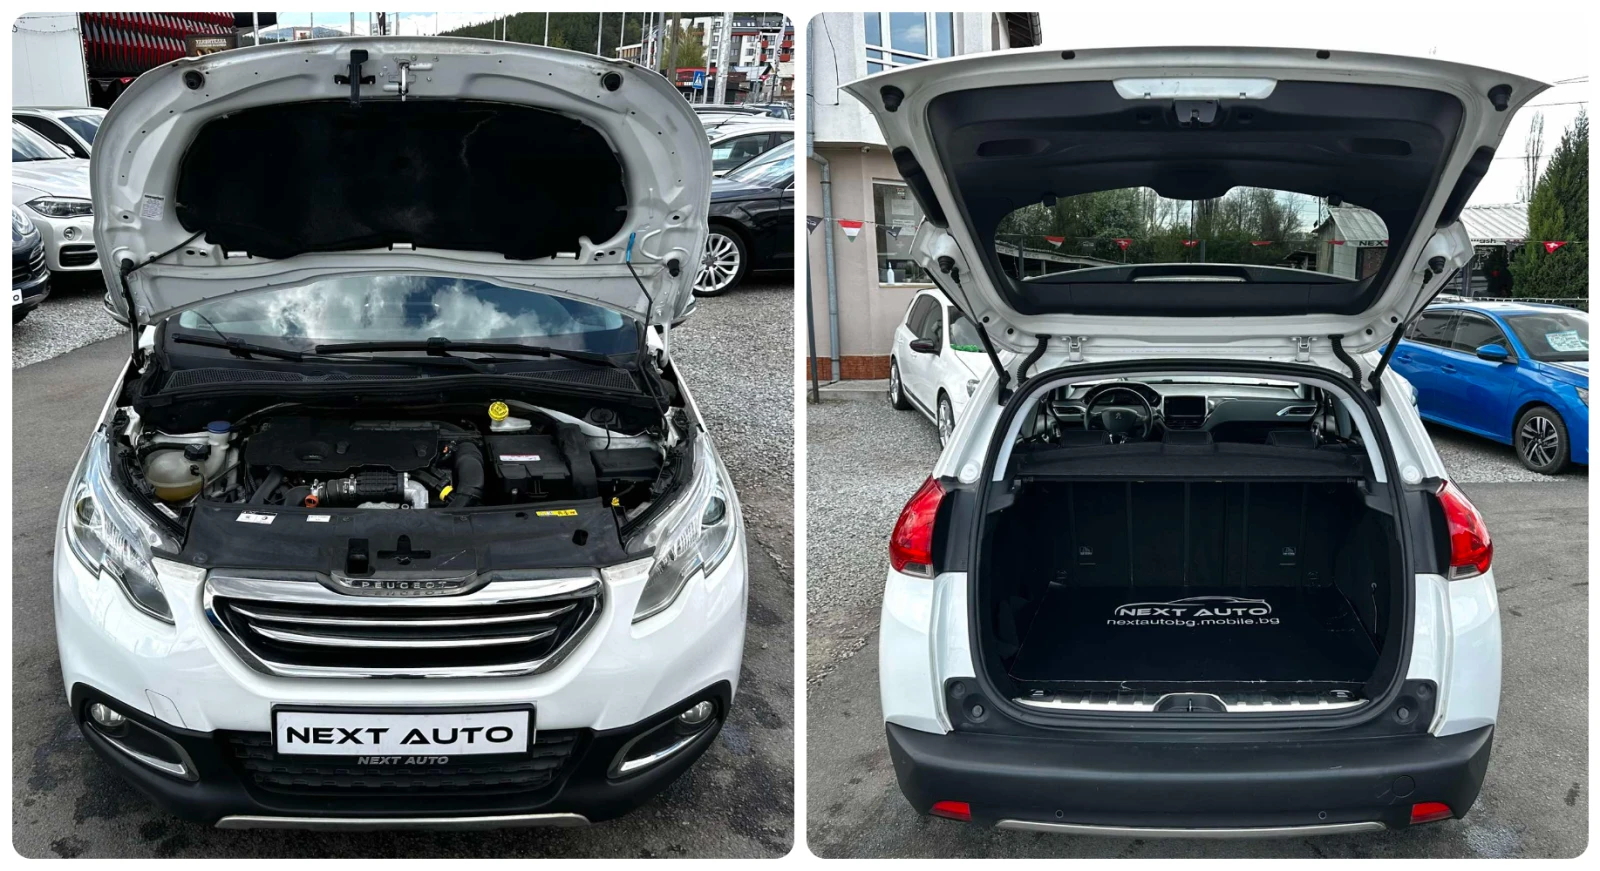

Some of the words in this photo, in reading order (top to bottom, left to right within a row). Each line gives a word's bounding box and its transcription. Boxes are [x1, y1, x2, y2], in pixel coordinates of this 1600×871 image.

[361, 581, 448, 590] PEUGEOT
[1119, 607, 1188, 617] NEXT
[1193, 607, 1268, 617] AUTO
[1106, 617, 1280, 628] nextautobg.mobile.bg
[286, 725, 390, 745] NEXT
[399, 725, 514, 745] AUTO
[357, 756, 402, 766] NEXT
[404, 756, 449, 766] AUTO
